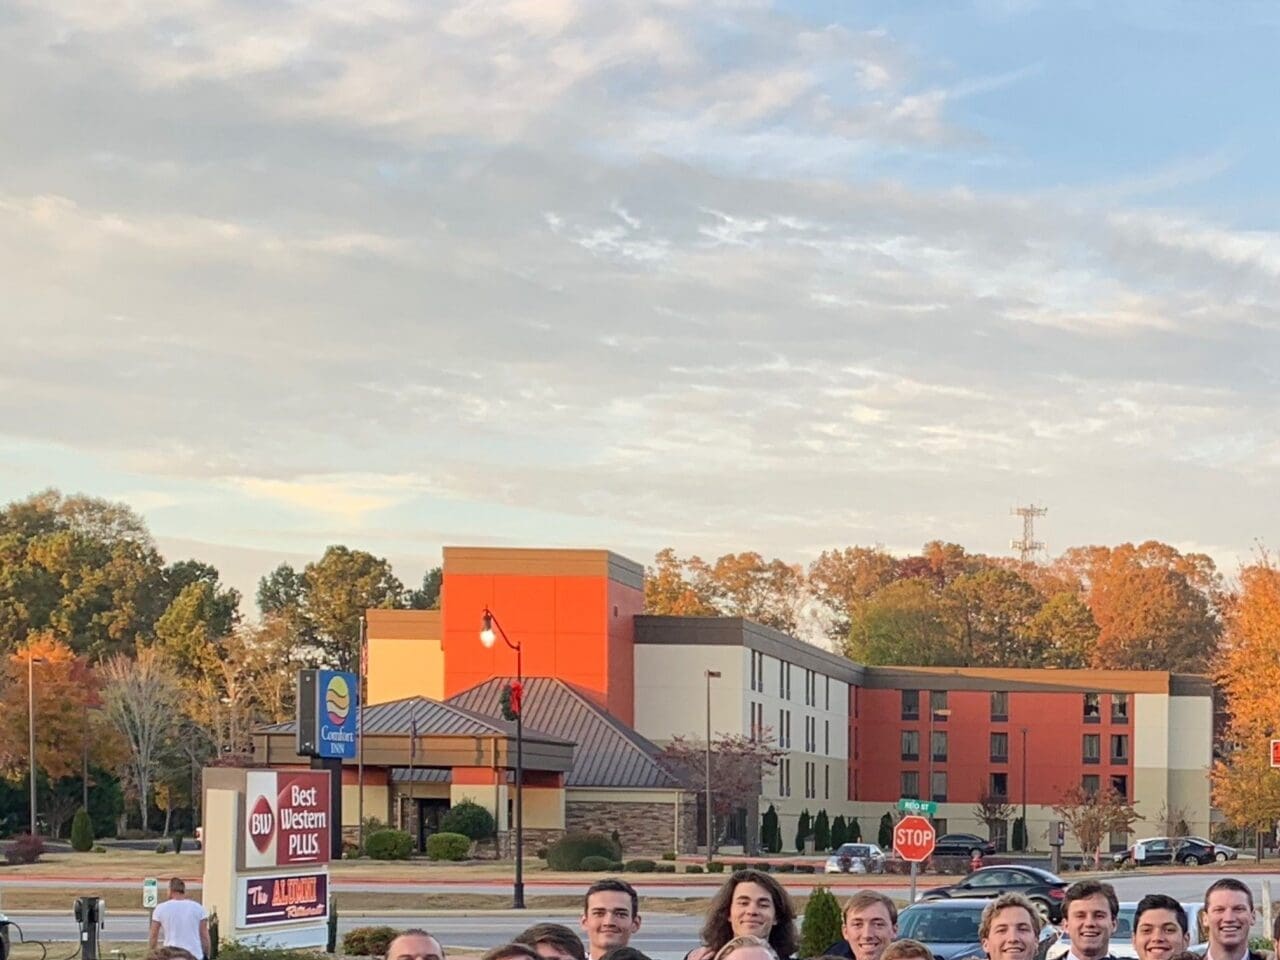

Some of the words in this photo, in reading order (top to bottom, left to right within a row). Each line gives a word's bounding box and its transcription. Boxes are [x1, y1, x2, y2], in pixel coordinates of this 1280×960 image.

[321, 724, 354, 742] Comfort
[330, 742, 345, 754] INN
[291, 784, 317, 807] Best
[251, 813, 272, 836] BW
[280, 808, 327, 830] Western
[288, 833, 319, 856] PLUS
[896, 828, 932, 847] STOP
[271, 876, 317, 907] ALUMNI
